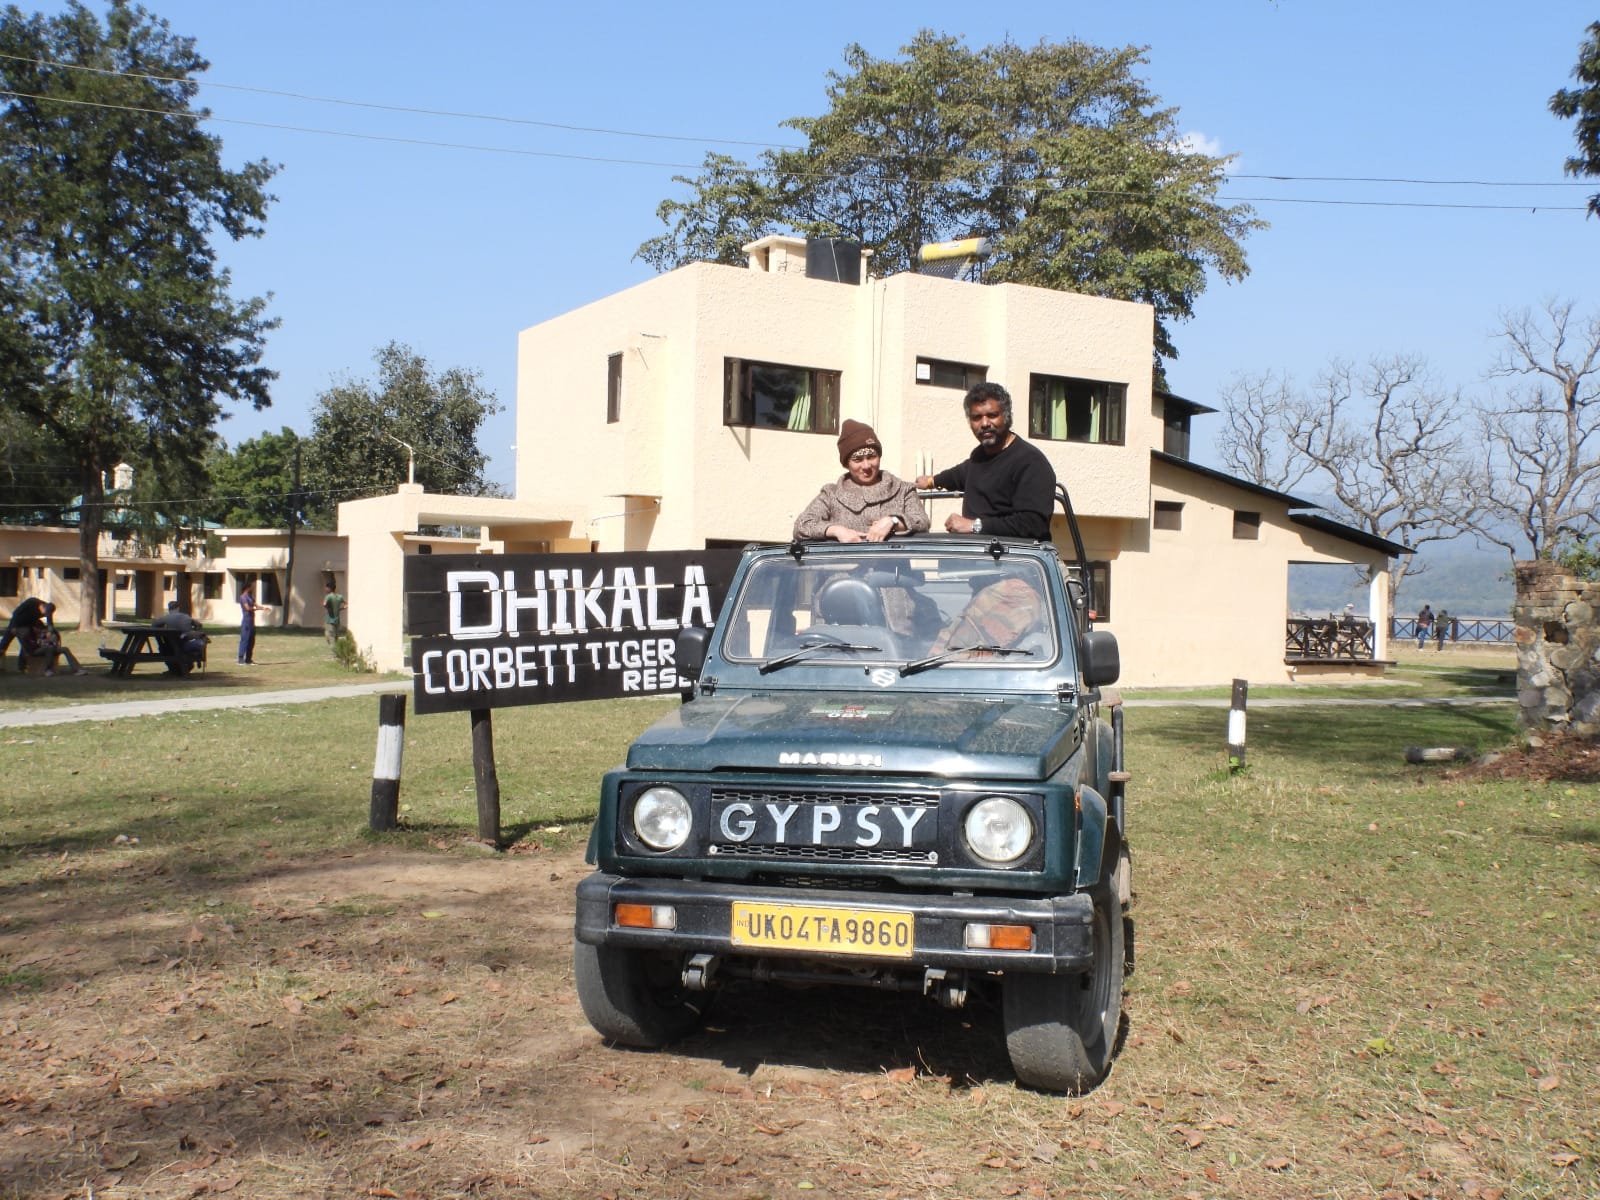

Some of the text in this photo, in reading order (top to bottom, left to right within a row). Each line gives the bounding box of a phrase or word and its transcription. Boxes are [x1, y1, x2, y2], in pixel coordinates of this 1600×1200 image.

[447, 565, 715, 639] DHIKALA
[422, 638, 676, 694] CORBETT TIGER
[623, 667, 697, 691] RESE
[779, 752, 882, 767] MARUTI
[719, 803, 926, 848] GYPSY
[748, 913, 909, 948] UK04TA9860
